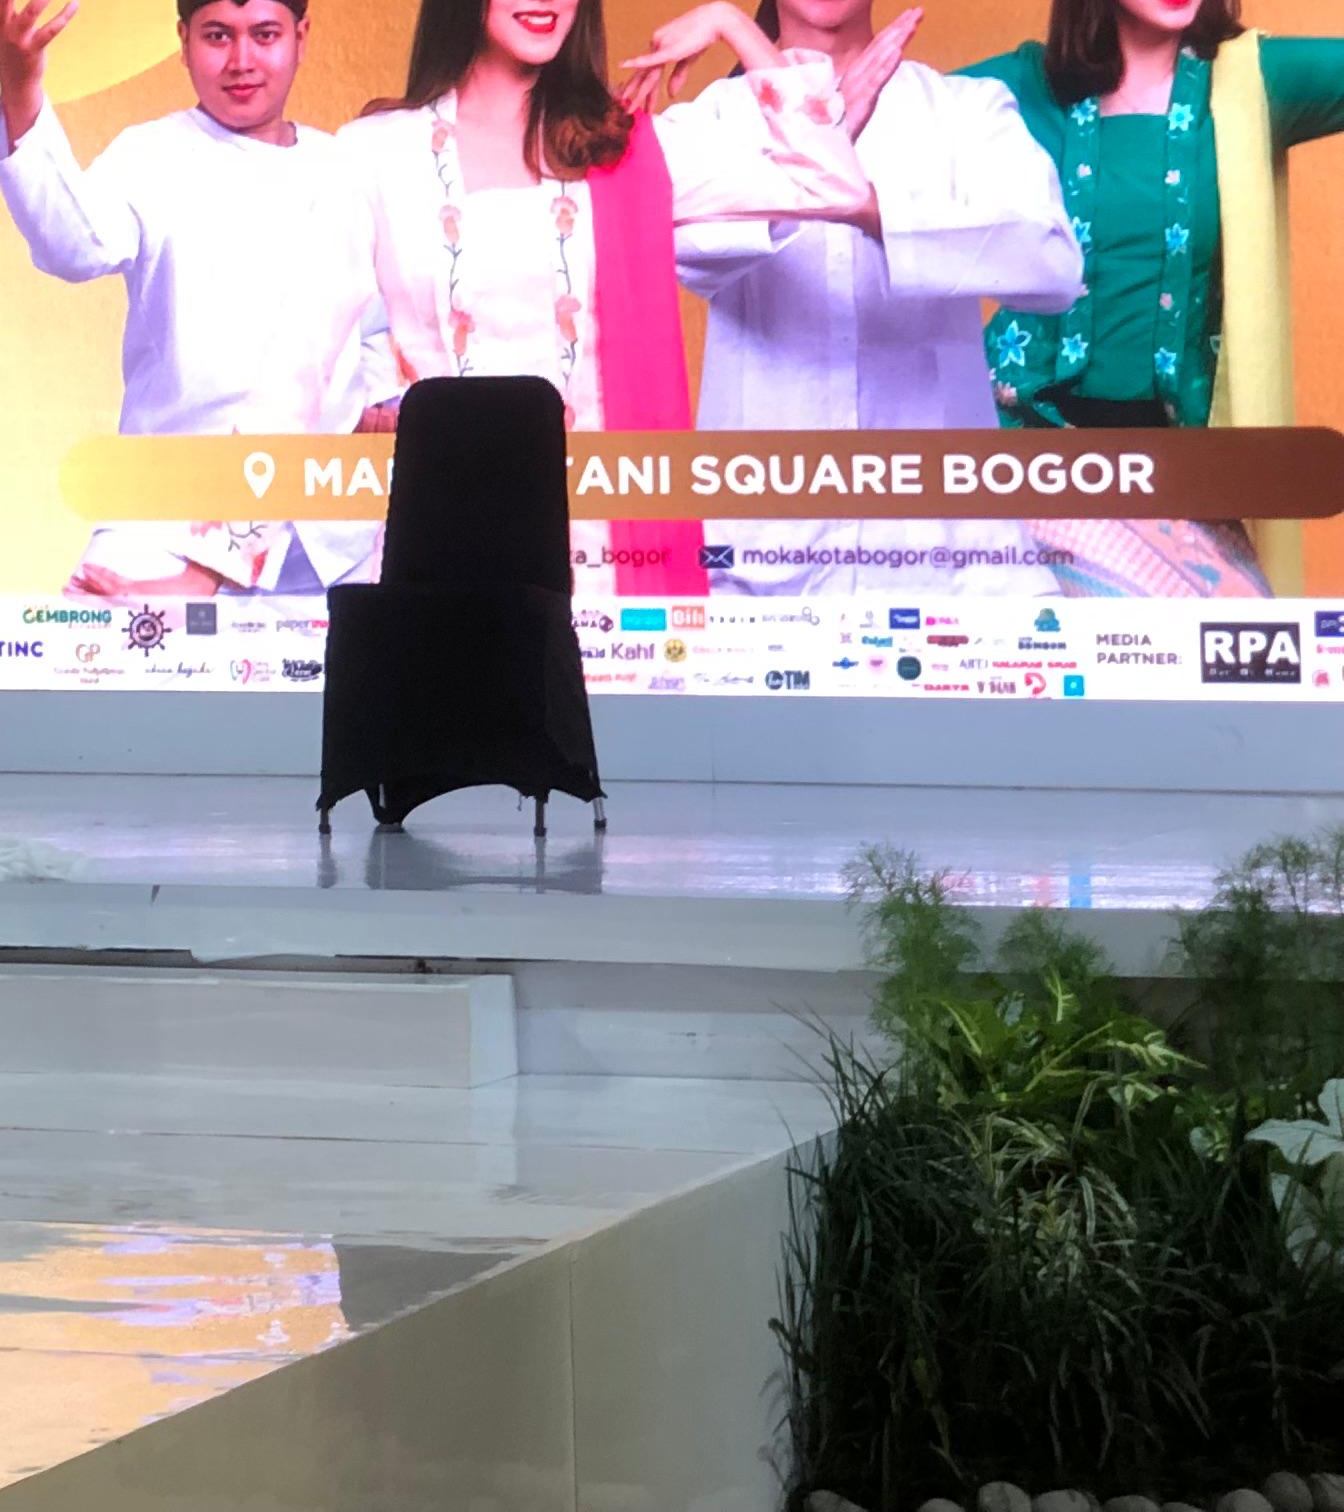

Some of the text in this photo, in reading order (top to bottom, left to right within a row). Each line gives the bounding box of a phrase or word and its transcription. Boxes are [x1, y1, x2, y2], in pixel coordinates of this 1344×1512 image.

[690, 453, 923, 496] SQUARE
[943, 452, 1155, 494] BOGOR
[742, 545, 1075, 569] mokakotabogor@gmail.com
[1096, 633, 1152, 646] MEDIA
[1204, 630, 1300, 665] RPA
[611, 642, 655, 660] Kahf
[1097, 652, 1182, 665] PARTNER:
